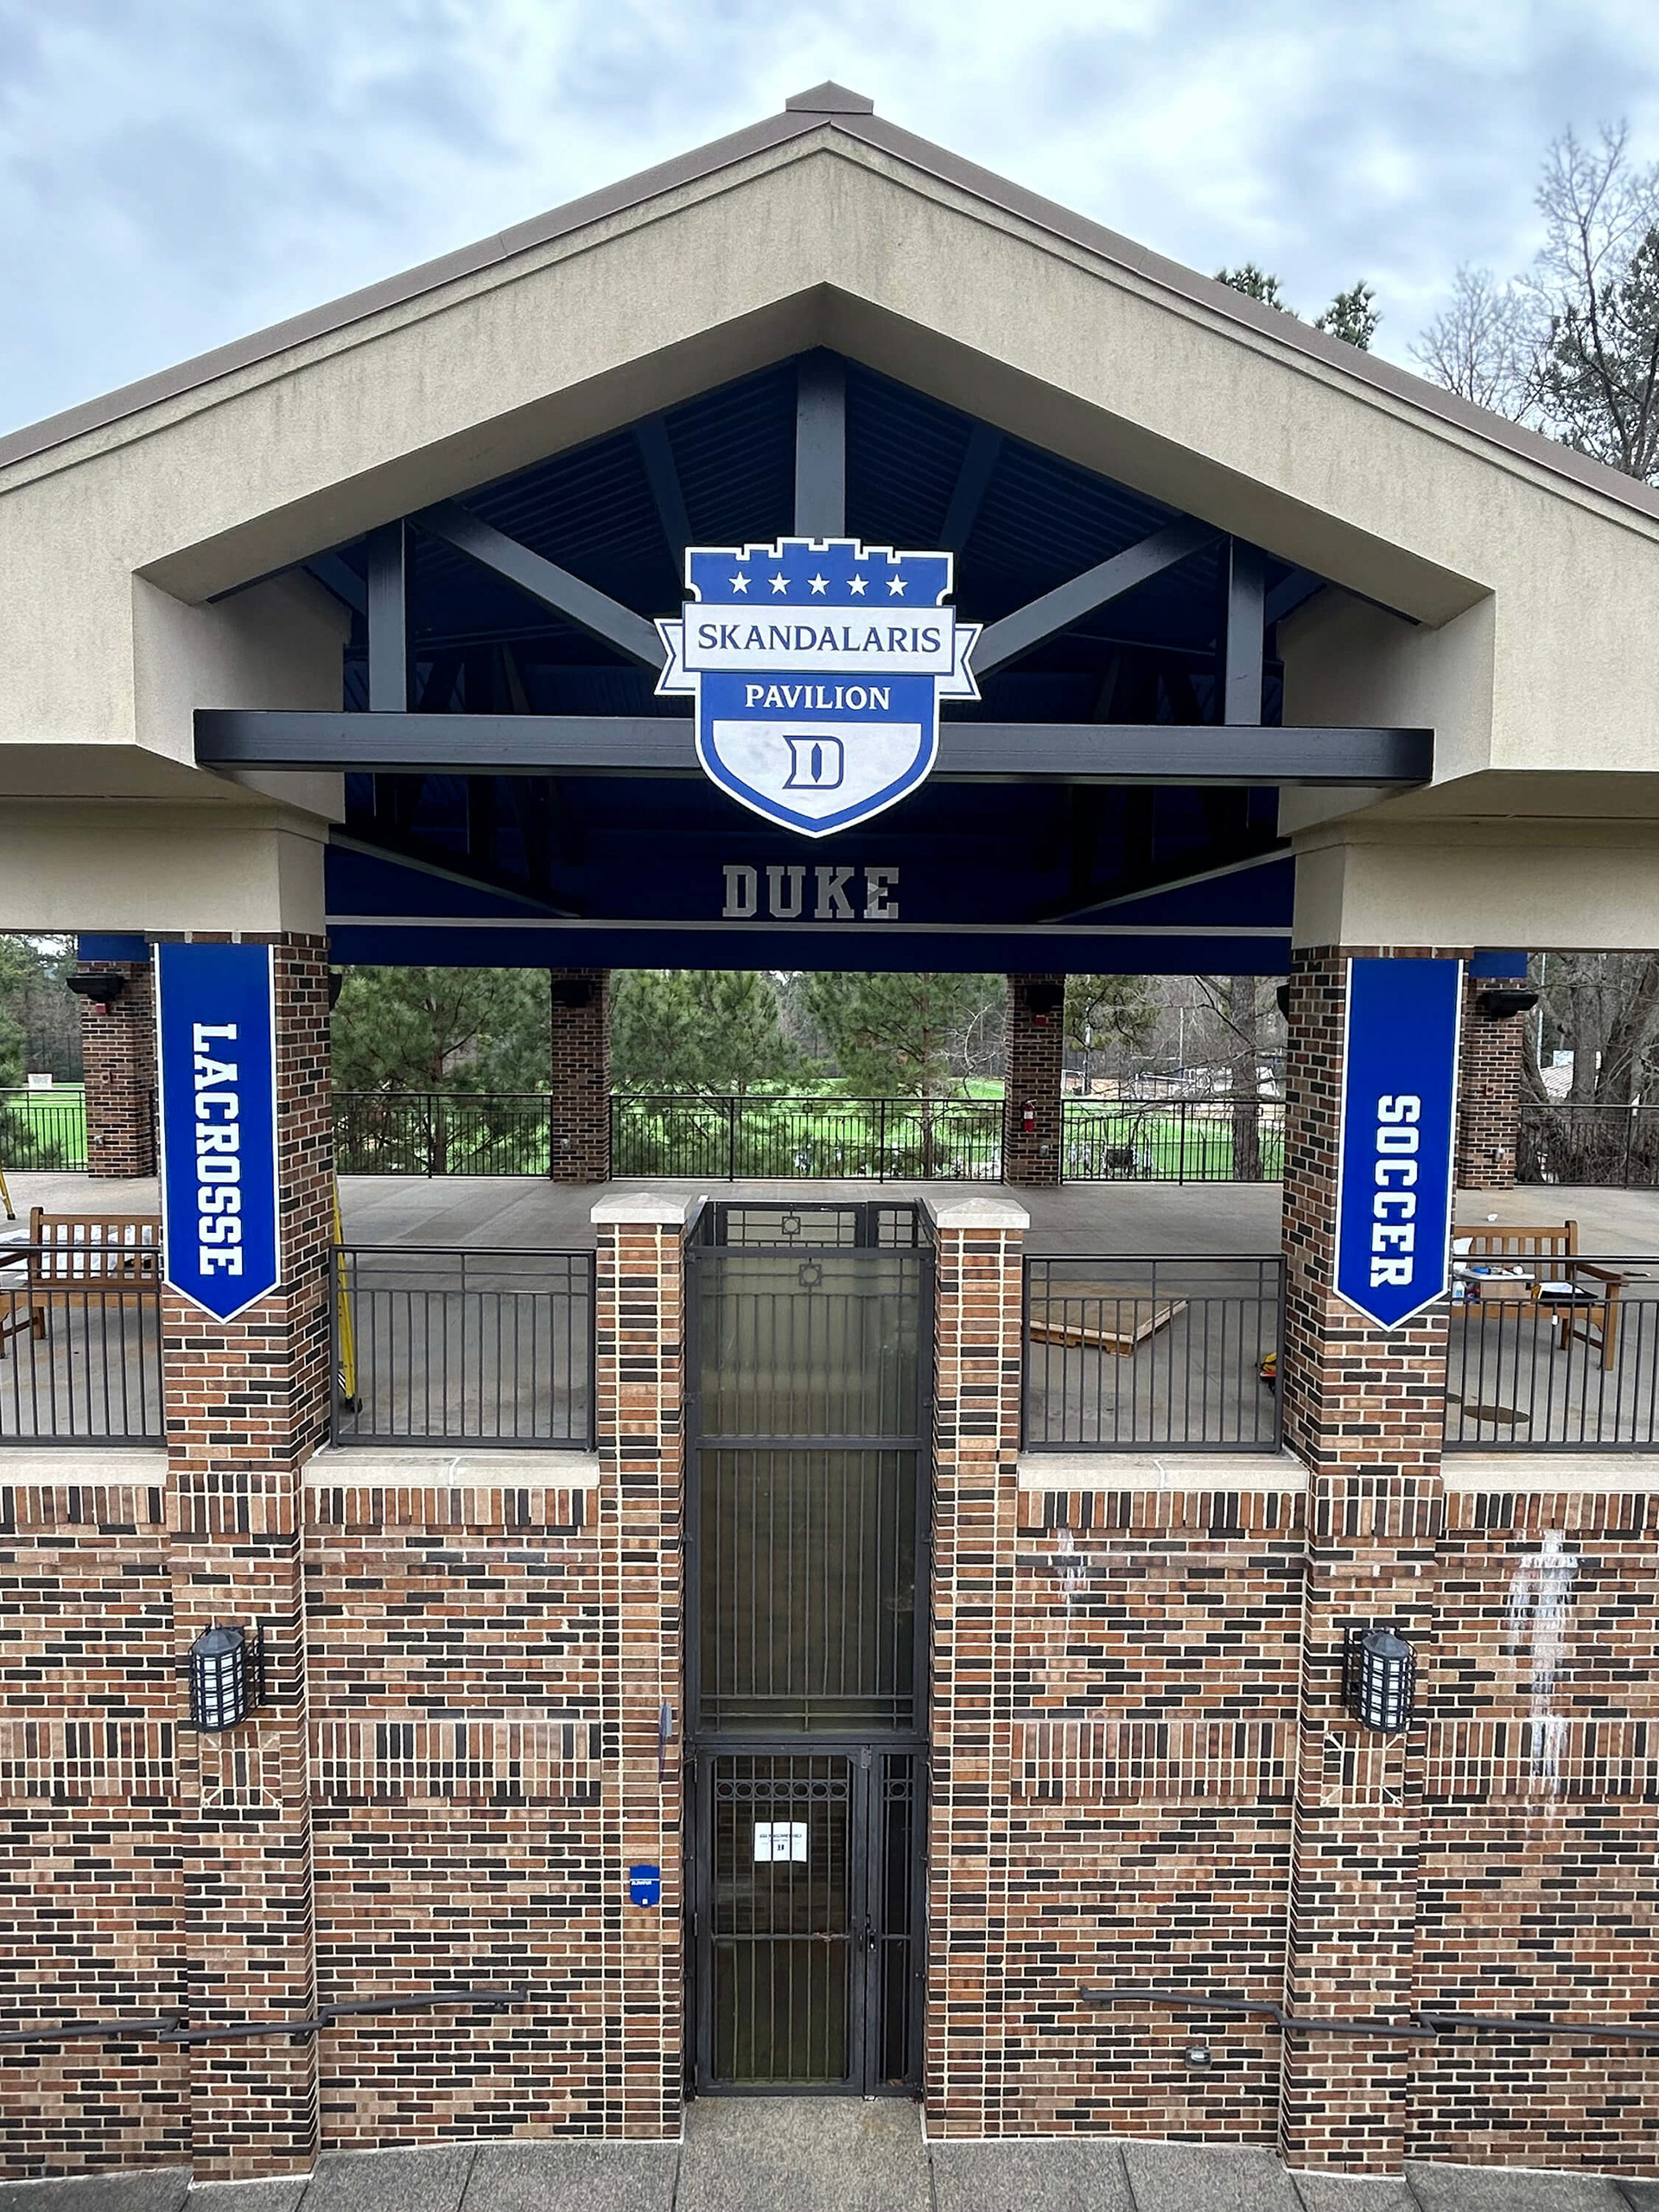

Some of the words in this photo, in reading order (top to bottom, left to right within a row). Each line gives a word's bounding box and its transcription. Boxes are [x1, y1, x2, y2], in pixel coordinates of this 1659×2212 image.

[697, 623, 942, 653] SKANDALARIS
[745, 683, 891, 710] PAVILION
[722, 865, 899, 919] DUKE
[193, 1022, 243, 1275] LACROSSE
[1370, 1095, 1421, 1287] SOCCER
